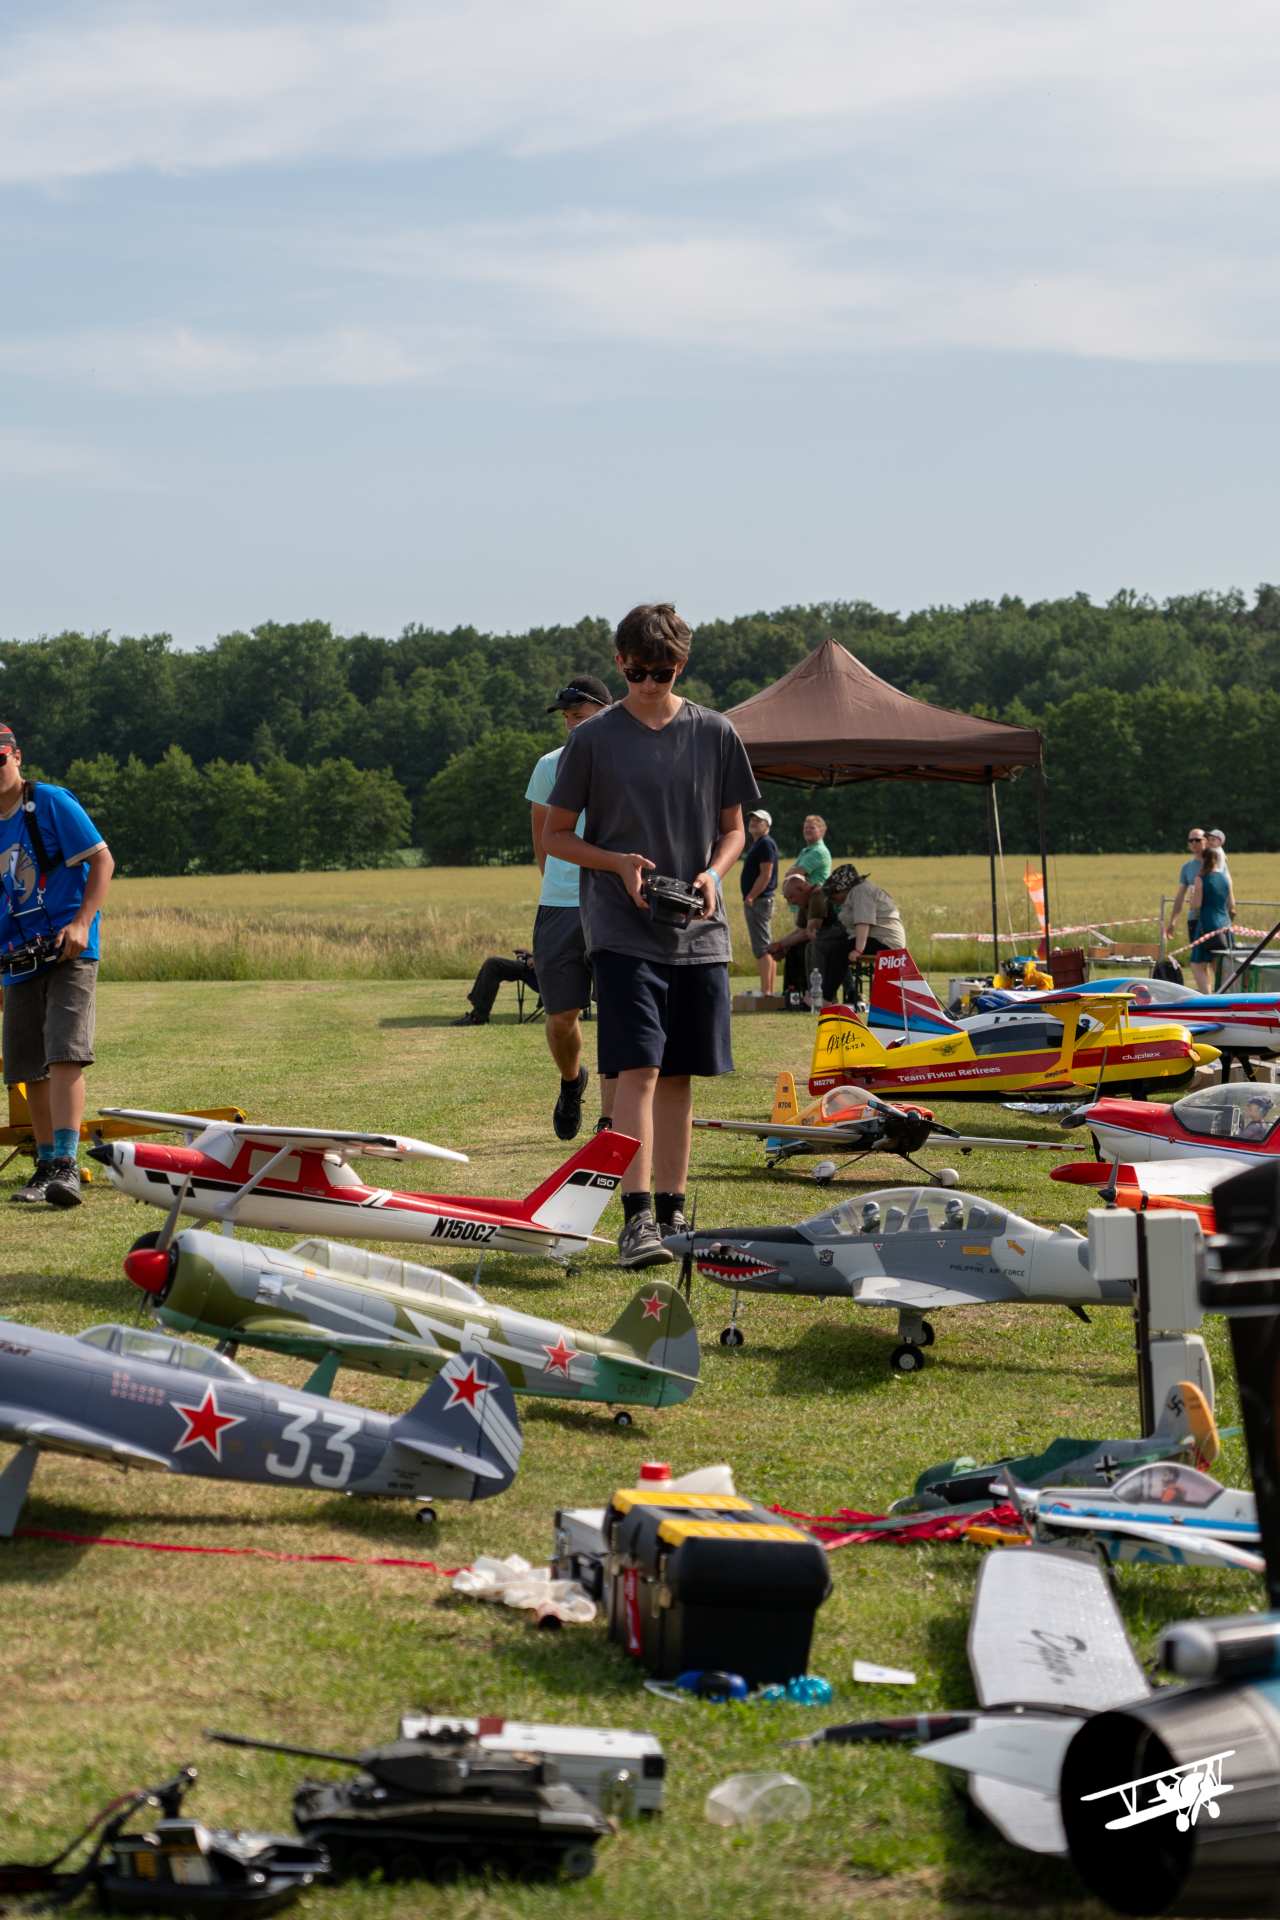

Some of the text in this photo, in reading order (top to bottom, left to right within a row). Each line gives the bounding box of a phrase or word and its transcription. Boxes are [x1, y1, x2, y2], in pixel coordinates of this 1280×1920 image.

[878, 954, 907, 970] Pilot
[826, 1030, 860, 1055] Pitts
[897, 1074, 926, 1083] Team
[958, 1066, 1001, 1077] Retirees
[595, 1177, 615, 1188] 150
[430, 1217, 498, 1243] N150CZ
[265, 1401, 363, 1489] 33
